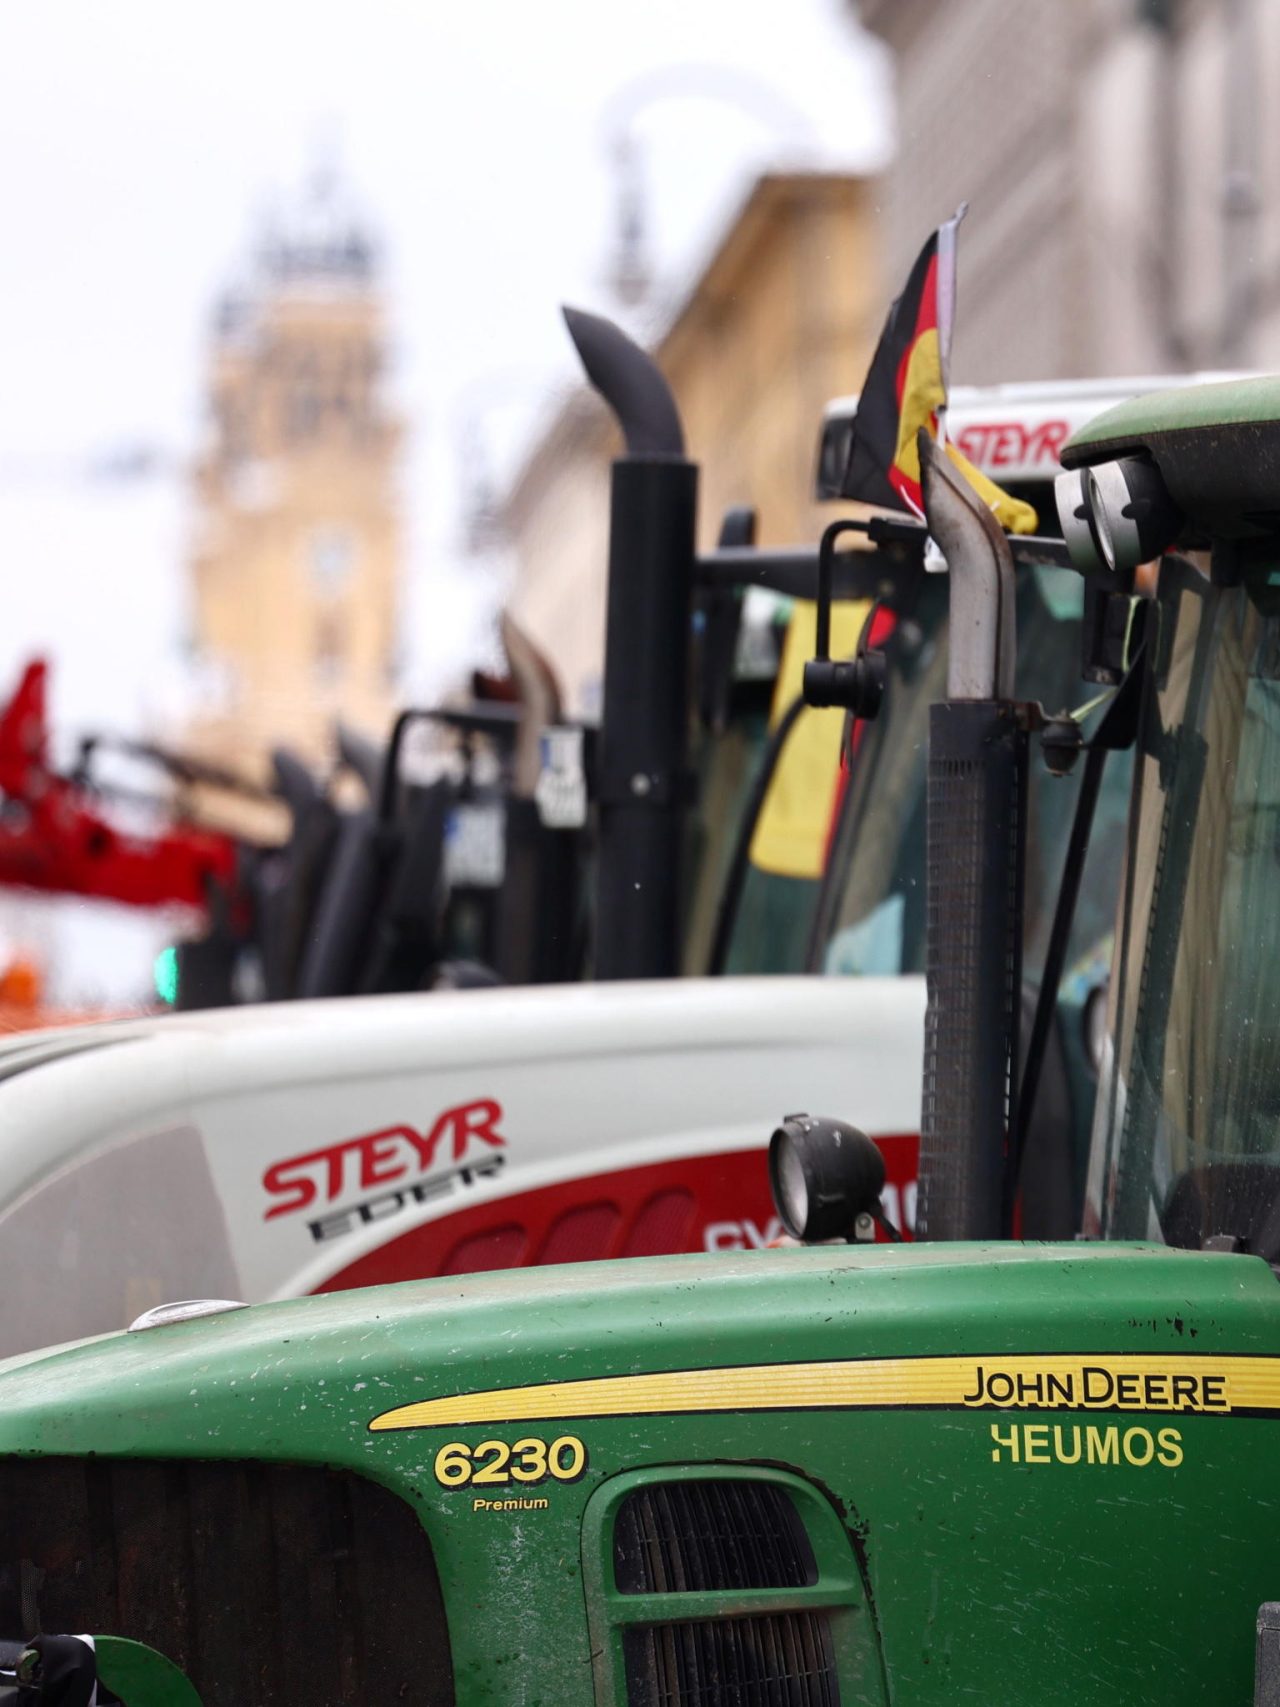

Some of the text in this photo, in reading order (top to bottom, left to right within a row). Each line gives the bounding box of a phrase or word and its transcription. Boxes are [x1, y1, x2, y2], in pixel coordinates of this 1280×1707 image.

[956, 417, 1069, 467] STEYR
[263, 1096, 508, 1222] STEYR
[307, 1154, 505, 1243] EDER
[703, 1215, 781, 1253] CV
[963, 1366, 1228, 1408] JOHN DEERE
[434, 1435, 587, 1488] 6230
[991, 1424, 1184, 1468] HEUMOS
[473, 1498, 549, 1512] Premium
